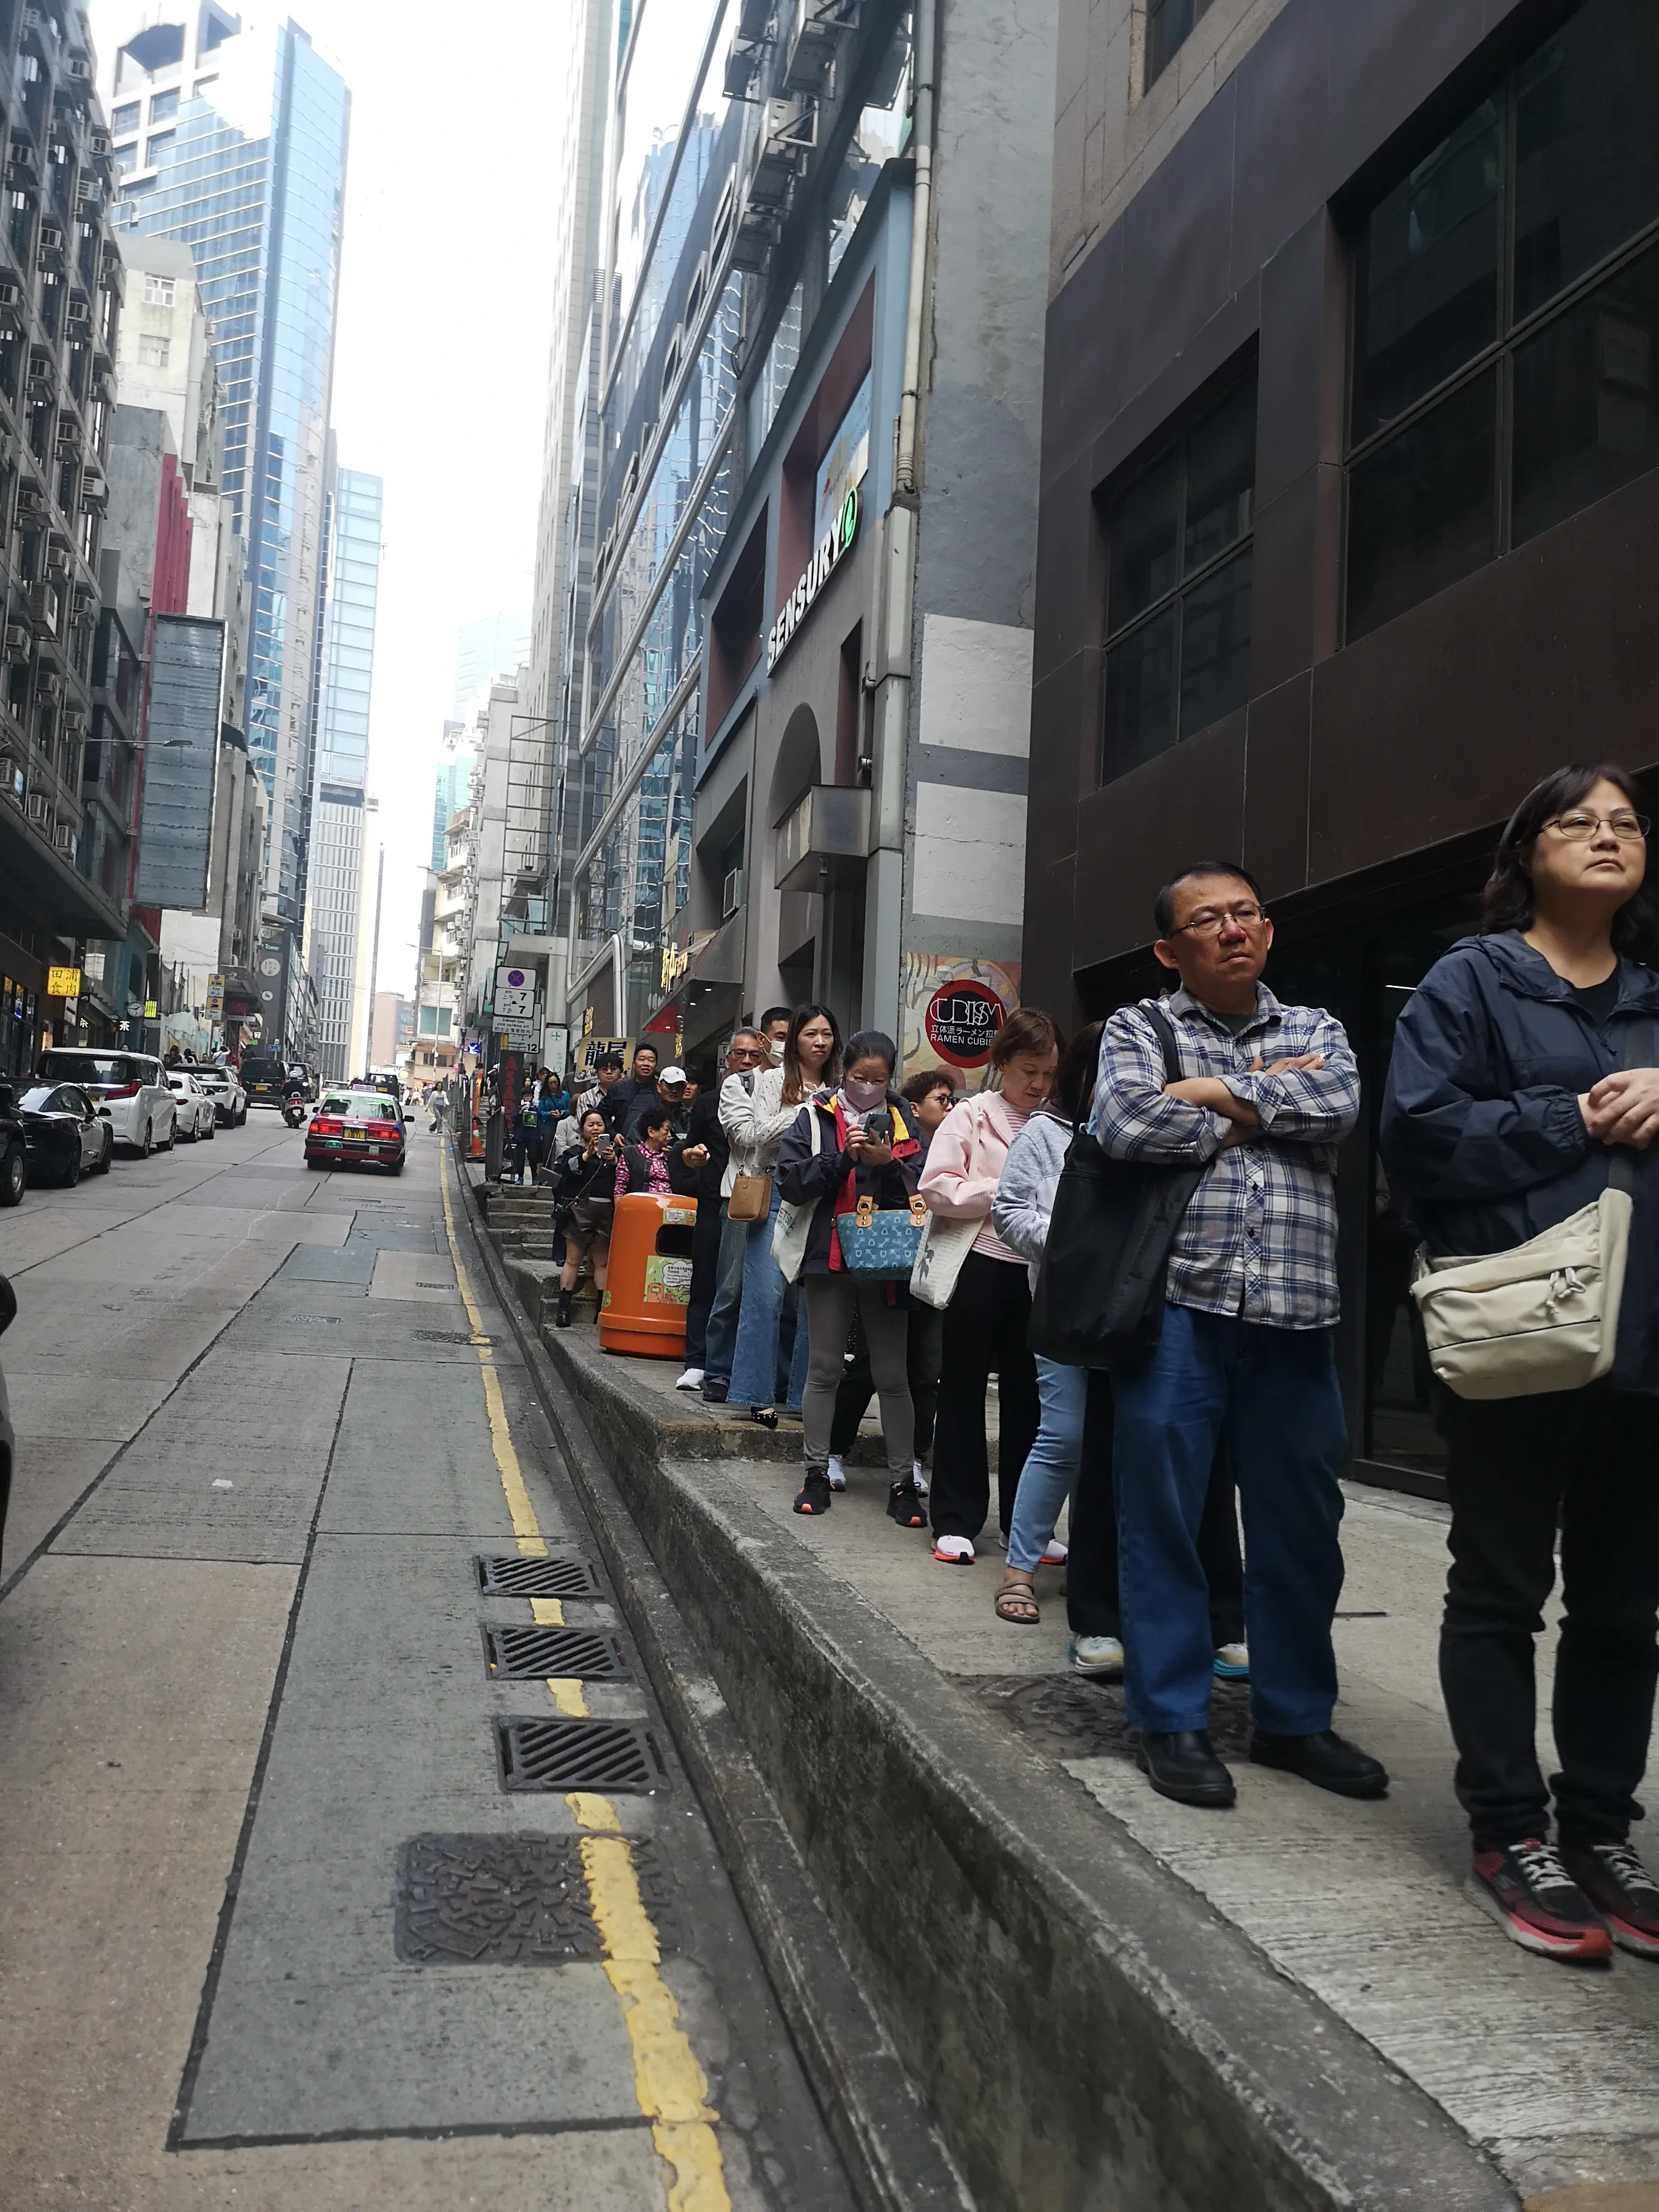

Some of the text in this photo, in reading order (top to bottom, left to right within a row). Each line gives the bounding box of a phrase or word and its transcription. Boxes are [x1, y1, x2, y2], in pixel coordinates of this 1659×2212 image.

[767, 504, 844, 671] SENSURY
[51, 982, 77, 995] 食肉
[518, 1005, 526, 1014] 7
[930, 997, 1004, 1026] CUBISM
[119, 1021, 130, 1031] 茶
[931, 1033, 993, 1047] RAMEN CUBIS
